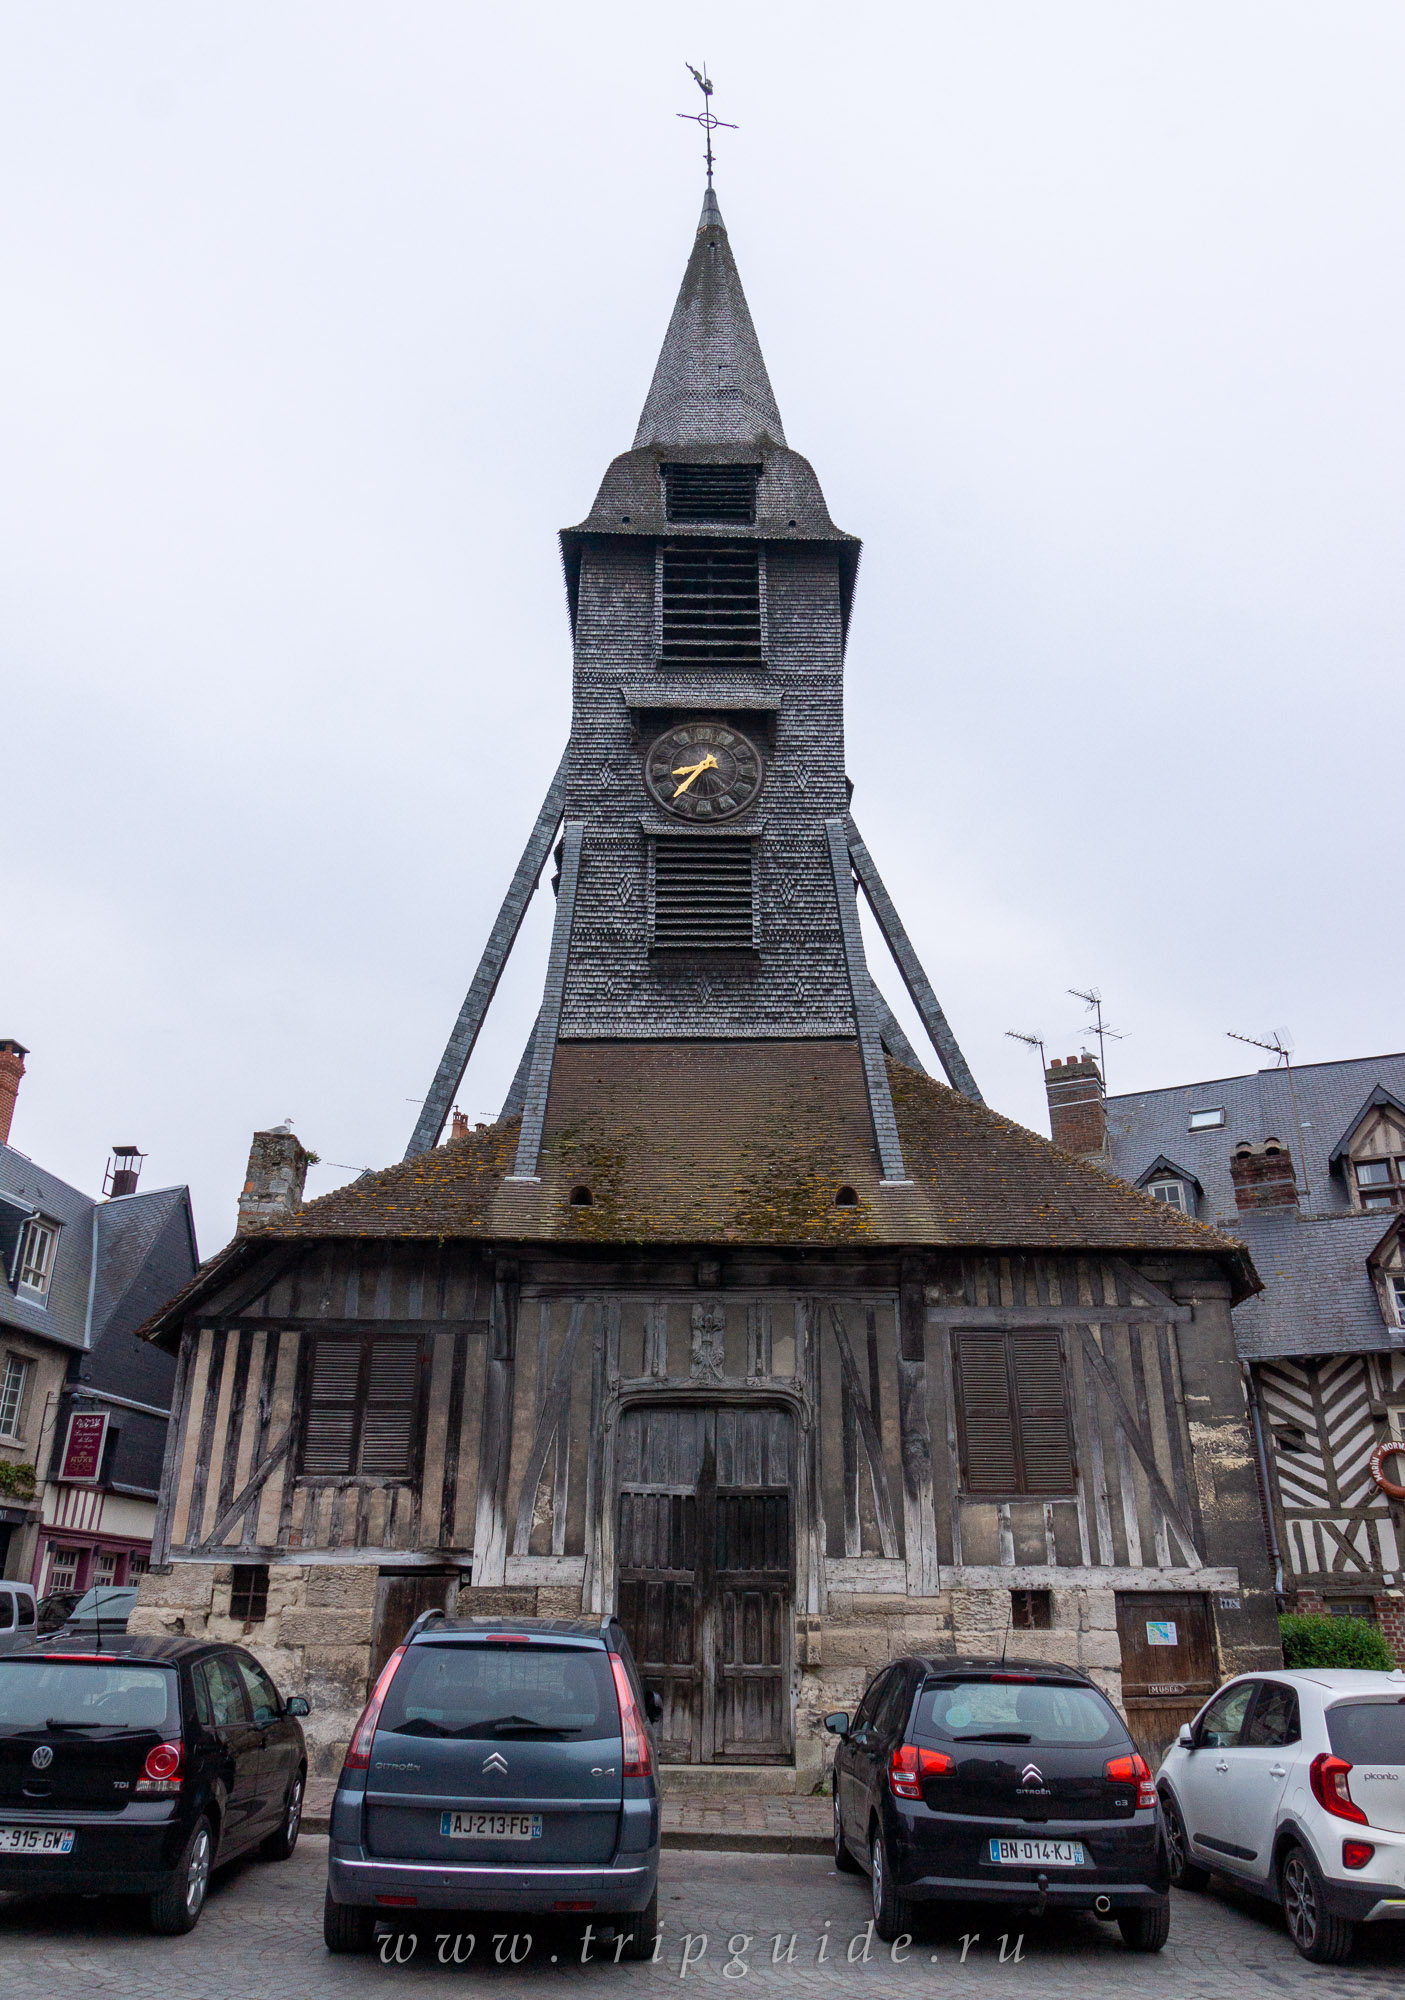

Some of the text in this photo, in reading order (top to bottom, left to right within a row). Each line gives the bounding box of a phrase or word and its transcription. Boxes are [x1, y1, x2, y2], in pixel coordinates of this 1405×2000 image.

[1370, 1457, 1383, 1481] MARIN
[1382, 1442, 1405, 1452] NORM
[590, 1767, 616, 1777] C4
[1363, 1772, 1399, 1781] picanto
[453, 1815, 530, 1834] AJ-213-FG
[63, 1841, 72, 1850] 77
[1000, 1842, 1072, 1860] BN-014-KJ
